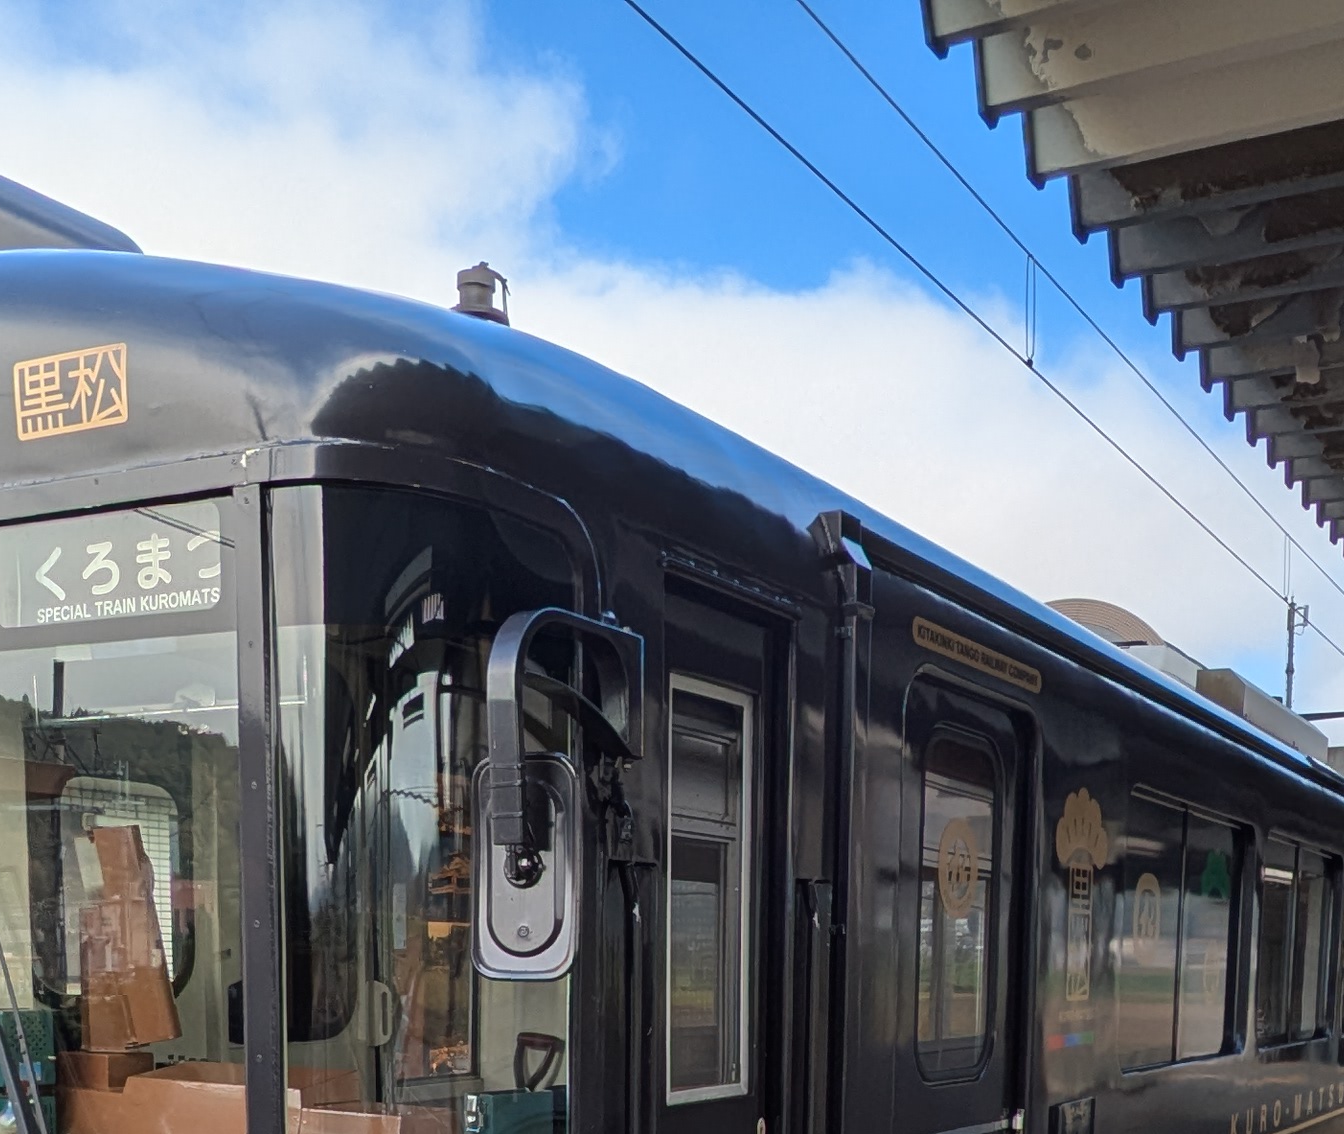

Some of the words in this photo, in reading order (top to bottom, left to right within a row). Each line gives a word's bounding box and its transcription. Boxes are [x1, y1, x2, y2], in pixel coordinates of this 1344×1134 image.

[13, 342, 129, 442] 黒松
[36, 602, 92, 624] SPECIAL
[94, 597, 137, 617] TRAIN
